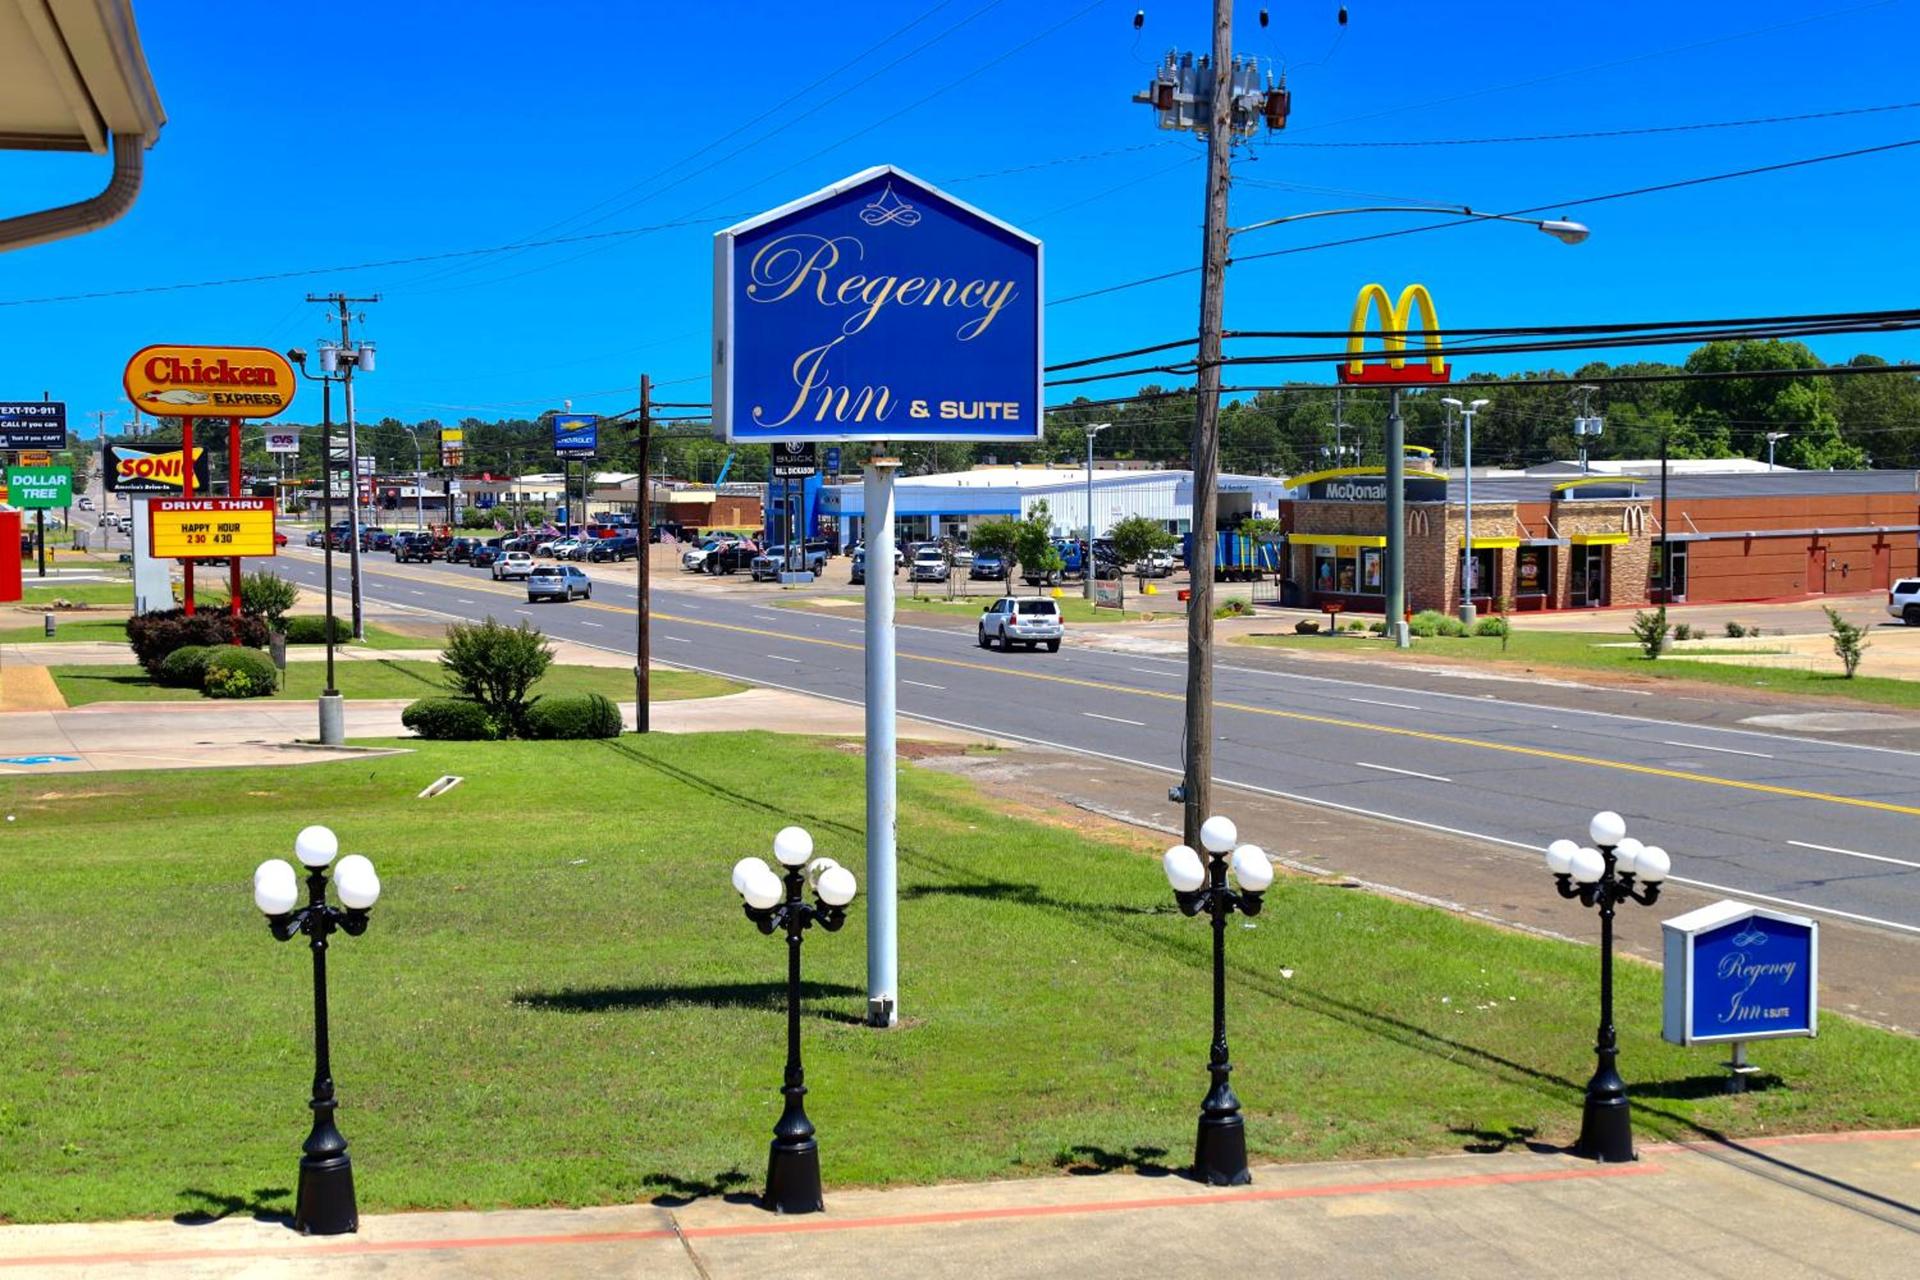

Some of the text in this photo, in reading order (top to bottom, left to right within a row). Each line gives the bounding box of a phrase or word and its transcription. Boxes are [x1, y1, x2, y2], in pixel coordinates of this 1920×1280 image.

[747, 234, 1019, 341] Regency
[144, 356, 277, 386] Chicken
[752, 335, 1019, 428] Inn & SUITE
[213, 393, 282, 405] EXPRESS
[272, 435, 293, 444] CVS
[120, 459, 196, 477] SONI
[12, 475, 66, 486] DOLLAR
[22, 489, 57, 499] TREE
[1326, 483, 1387, 499] McDonal
[161, 501, 264, 510] DRIVE THRU
[181, 523, 240, 533] HAPPY HOUR
[1718, 952, 1796, 985] Regency
[1718, 988, 1760, 1023] Inn
[1769, 1007, 1790, 1018] SUITE
